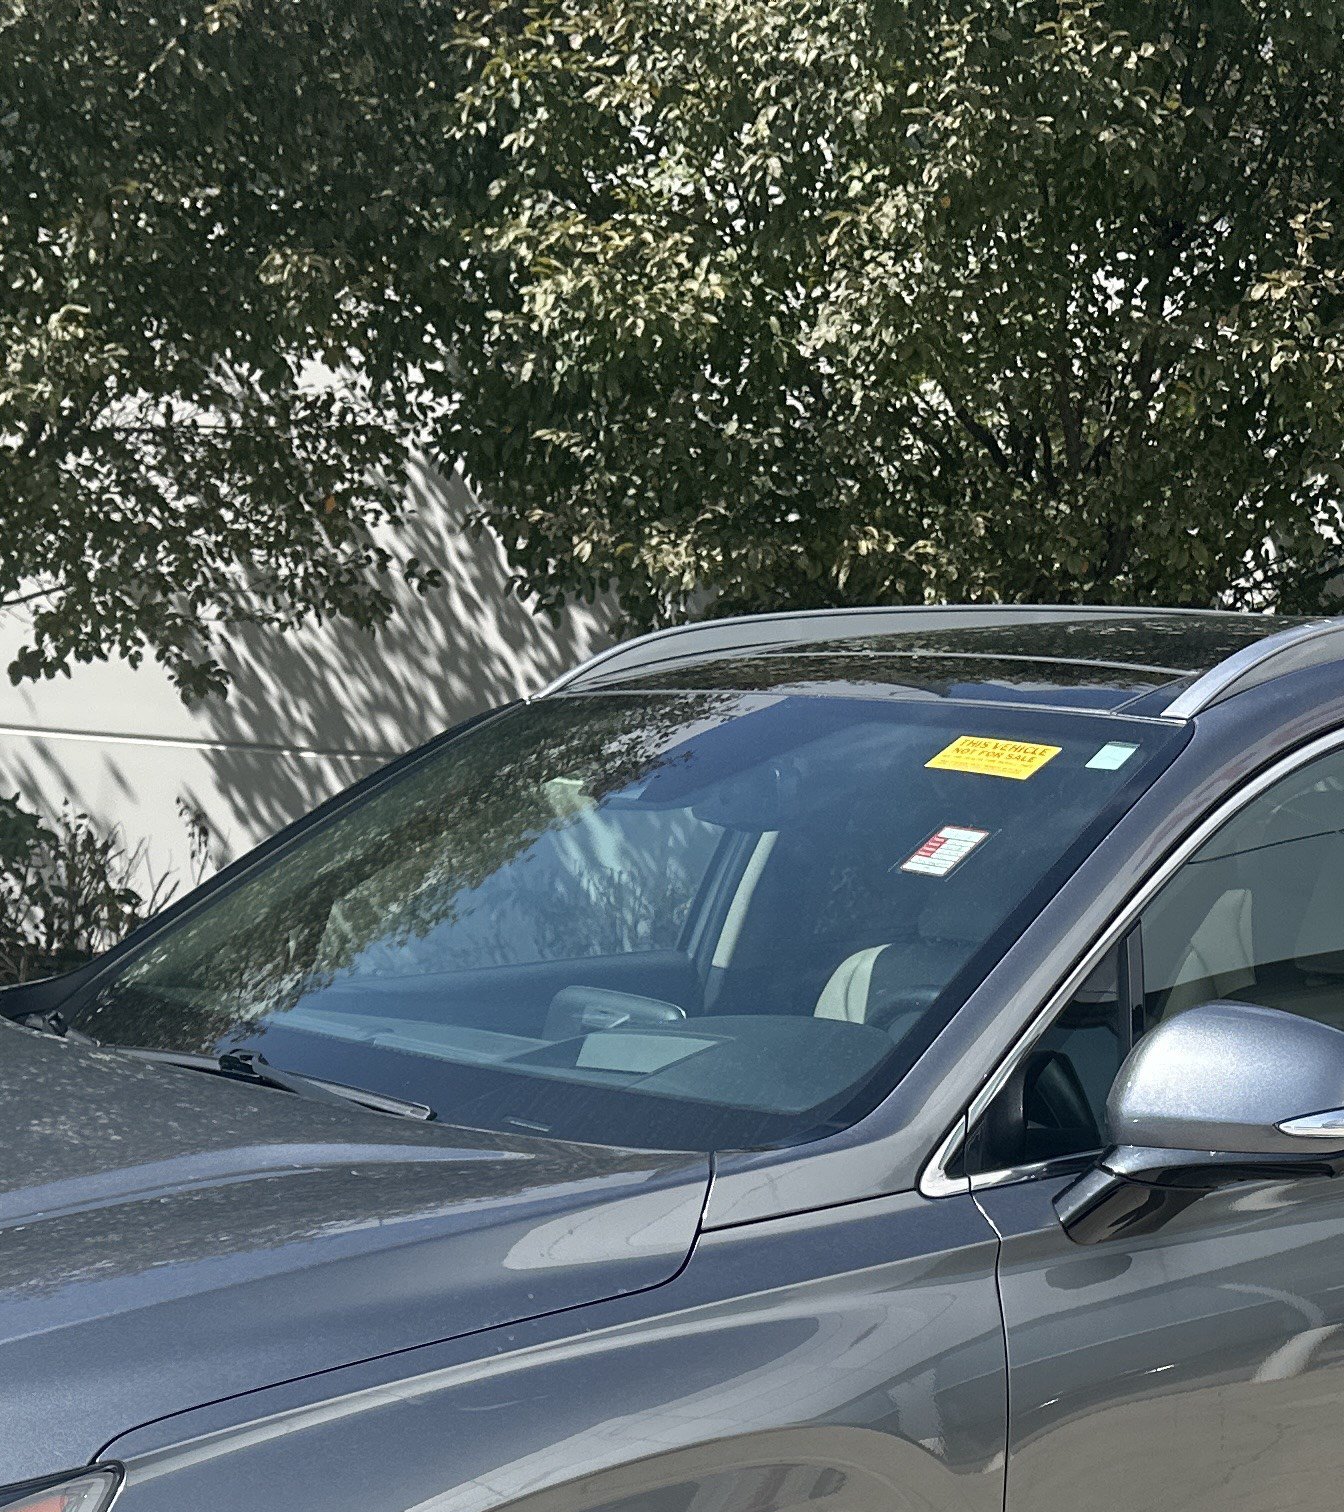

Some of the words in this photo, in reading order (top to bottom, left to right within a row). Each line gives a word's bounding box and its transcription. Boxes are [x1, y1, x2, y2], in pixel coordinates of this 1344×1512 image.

[952, 747, 976, 756] NOT
[978, 750, 1003, 759] FOR
[1006, 753, 1037, 763] SALE
[959, 739, 989, 749] THIS
[992, 742, 1051, 757] VEHICLE
